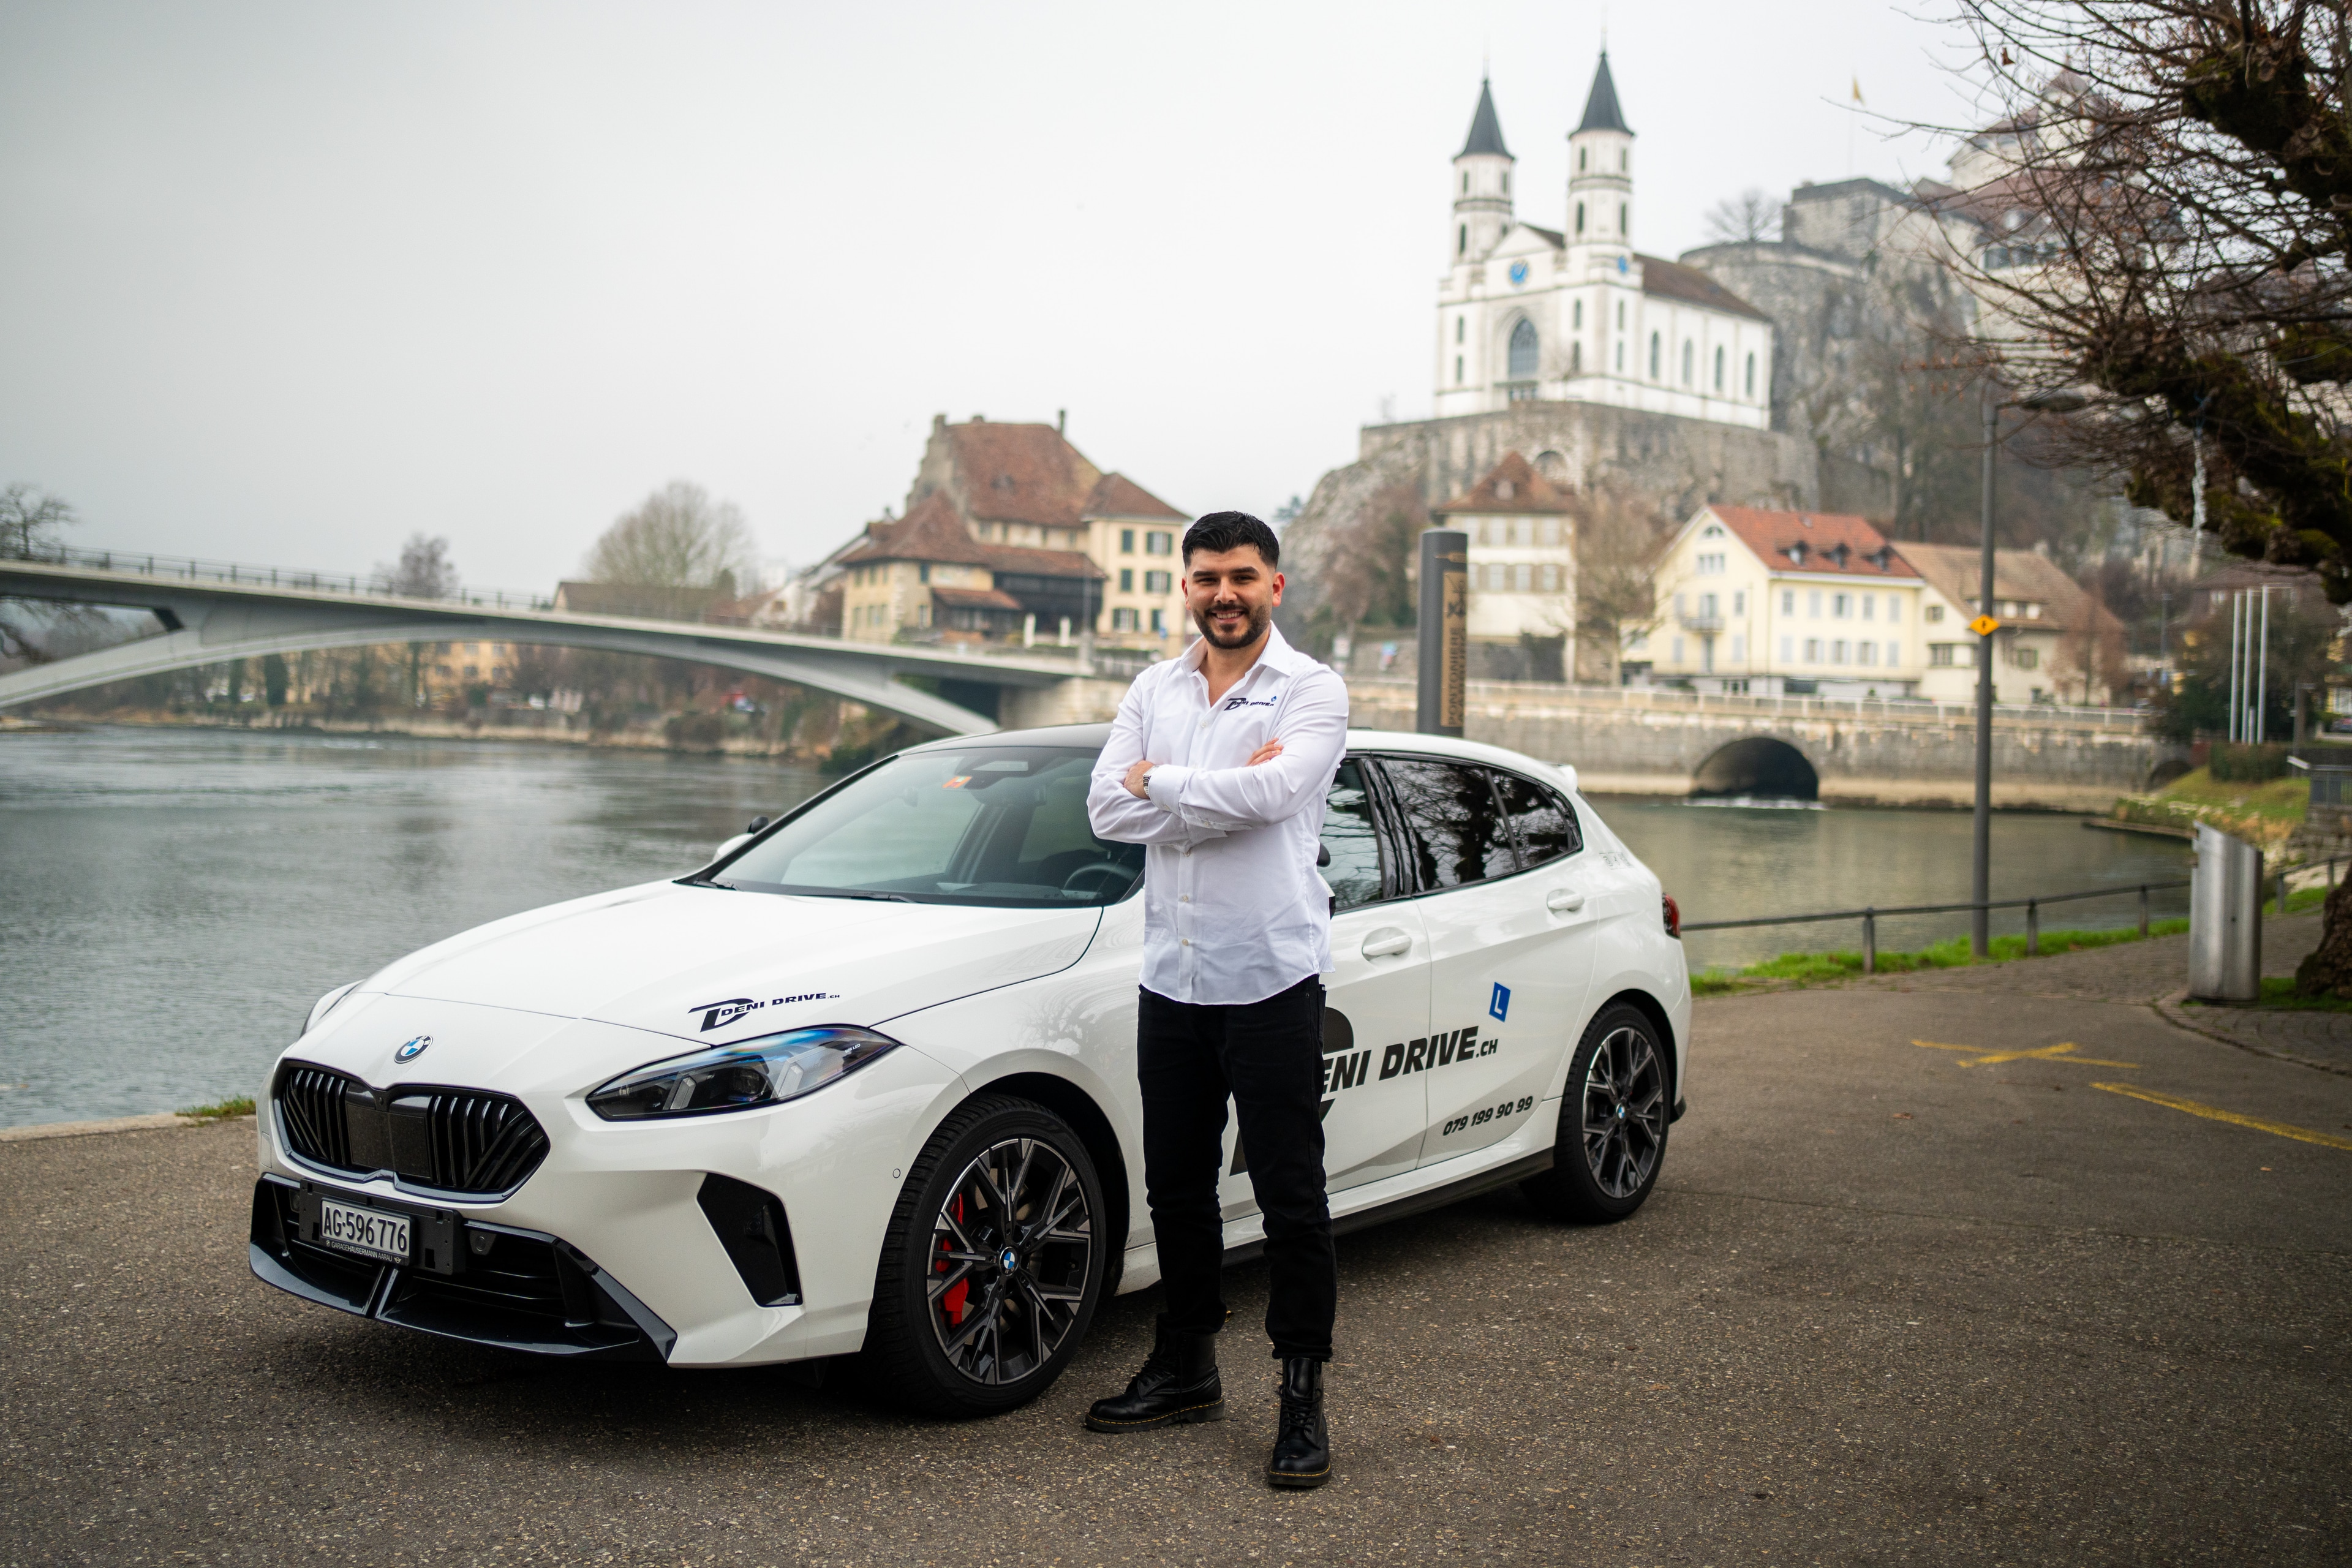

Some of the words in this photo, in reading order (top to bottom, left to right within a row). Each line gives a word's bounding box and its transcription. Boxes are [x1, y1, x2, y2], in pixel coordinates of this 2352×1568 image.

[721, 1001, 765, 1017] DENI
[1494, 989, 1503, 1016] L
[1442, 1115, 1469, 1136] 079
[1471, 1107, 1494, 1127] 199
[1495, 1101, 1514, 1119] 90
[1516, 1096, 1534, 1114] 99
[378, 1253, 393, 1262] AARAU
